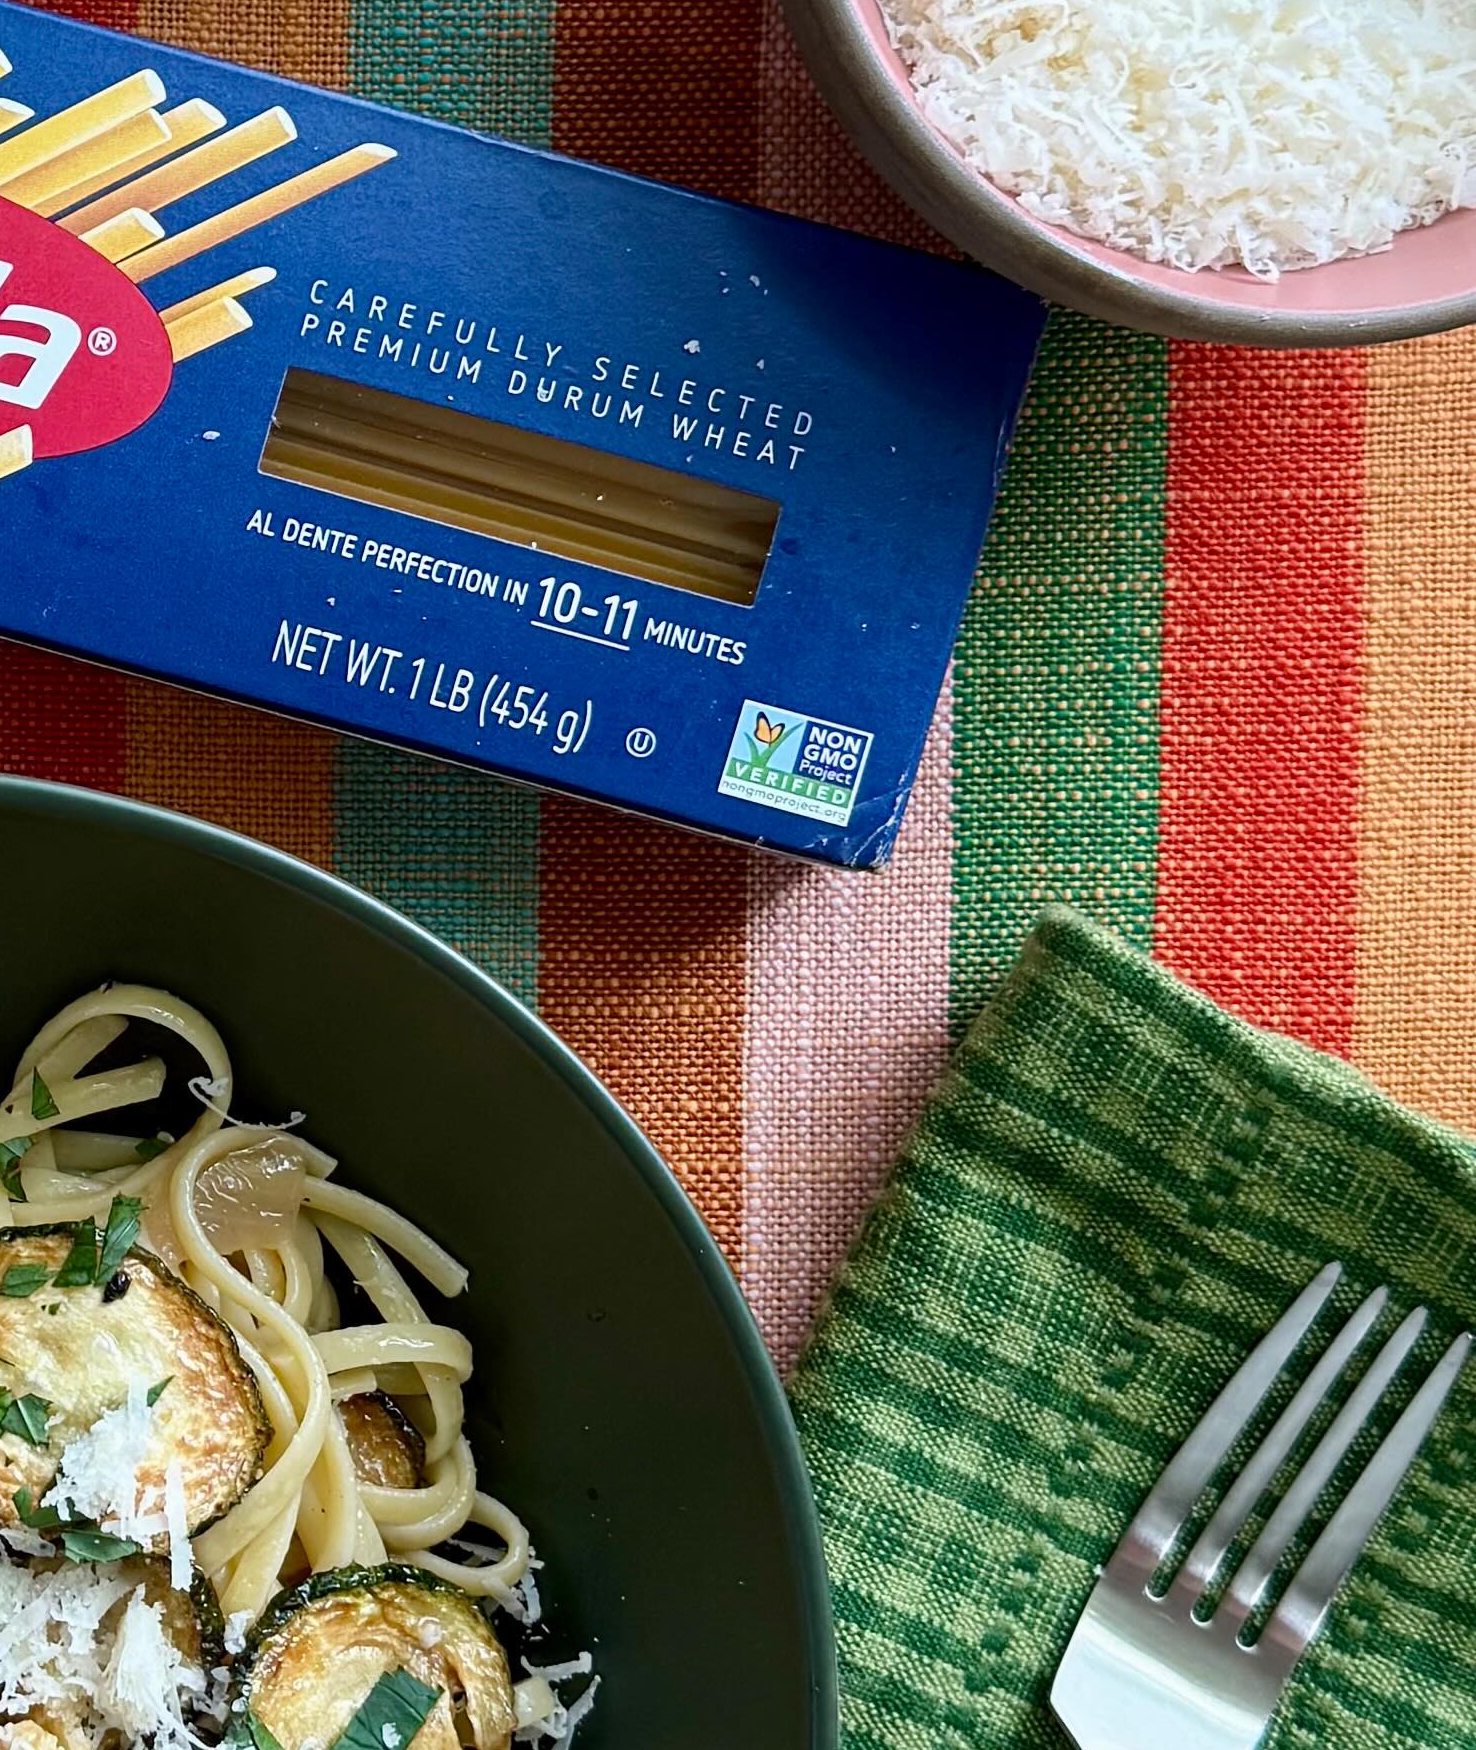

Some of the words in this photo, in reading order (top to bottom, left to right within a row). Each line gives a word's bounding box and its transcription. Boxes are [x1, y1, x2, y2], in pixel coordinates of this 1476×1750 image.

[309, 279, 564, 368] CAREFULLY
[591, 355, 814, 437] SELECTED
[299, 313, 484, 385] PREMIUM
[508, 368, 645, 429] DURUM
[671, 413, 807, 471] WHEAT
[246, 509, 276, 538] AL
[281, 517, 358, 560] DENTE
[360, 539, 498, 596] PERFECTION
[502, 579, 529, 606] IN
[536, 576, 639, 640] 10-11
[643, 617, 748, 666] MINUTES
[271, 619, 342, 676] NET
[344, 634, 404, 694] WT.
[409, 658, 427, 700] 1
[428, 664, 475, 712] LB
[479, 674, 549, 737] (454
[552, 699, 594, 754] g)
[803, 744, 855, 772] GMO
[809, 726, 862, 755] NON
[733, 761, 848, 805] VERIFIED
[798, 760, 853, 787] Project
[722, 779, 847, 822] nongmoproject.org
